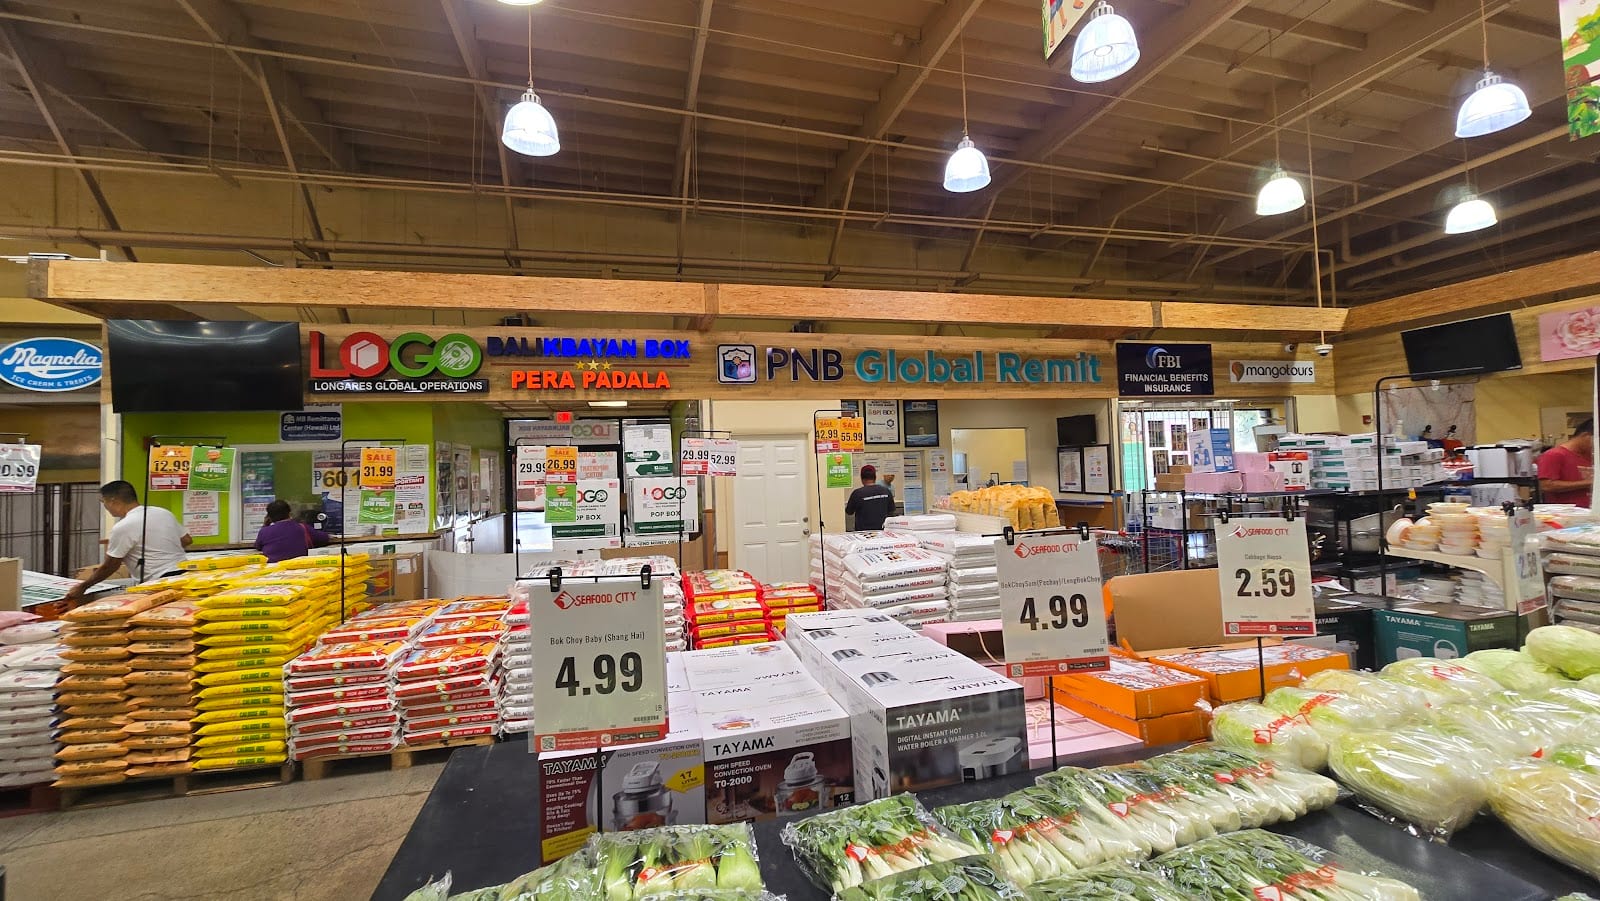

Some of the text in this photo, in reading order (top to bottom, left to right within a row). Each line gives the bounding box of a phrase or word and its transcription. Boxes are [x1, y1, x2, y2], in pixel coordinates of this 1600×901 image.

[309, 331, 482, 378] LOGO
[487, 337, 690, 359] BALIKBAYAN BOX
[3, 347, 102, 372] Magnolia
[766, 347, 1101, 383] PNB Global Remit
[1158, 355, 1181, 368] FBI
[1125, 373, 1209, 382] FINANCIAL BENEFITS
[1246, 366, 1313, 378] mangotours
[11, 374, 93, 387] ICE CREAM & TREATS
[314, 381, 483, 391] LONGARES GLOBAL OPERATIONS
[511, 370, 671, 389] PERA PADALA
[1144, 384, 1192, 393] INSURANCE
[841, 432, 863, 442] 55.99
[682, 450, 736, 465] 29.99 52.99
[0, 464, 35, 477] 0.99
[154, 460, 190, 472] 12.99
[547, 459, 576, 470] 26.99
[364, 466, 393, 477] 31.99
[577, 489, 608, 503] OGO
[1247, 528, 1289, 537] SEAFOOD CITY
[1031, 544, 1079, 556] SEAFOOD CITY
[1235, 568, 1296, 598] 2.59
[575, 591, 637, 606] SEAFOOD CITY
[1020, 593, 1089, 631] 4.99
[1384, 616, 1421, 626] TAYAMA
[1469, 623, 1495, 632] TAYAMA
[550, 631, 645, 645] Bok Choy Baby (Shang Hai)
[555, 652, 643, 697] 4.99
[700, 687, 752, 697] TAYAMA
[896, 708, 961, 730] TAYAMA
[897, 727, 962, 744] DIGITAL INSTANT HOT
[713, 736, 774, 756] TAYAMA
[897, 741, 919, 752] WATER
[920, 739, 942, 748] BOILER
[948, 733, 974, 743] WARMER
[651, 745, 685, 754] CONVECTION
[543, 755, 606, 776] TAYAM
[713, 760, 751, 770] HIGH SPEED
[714, 764, 772, 778] CONVECTION OVEN
[680, 770, 693, 780] 17
[839, 793, 850, 801] 12
